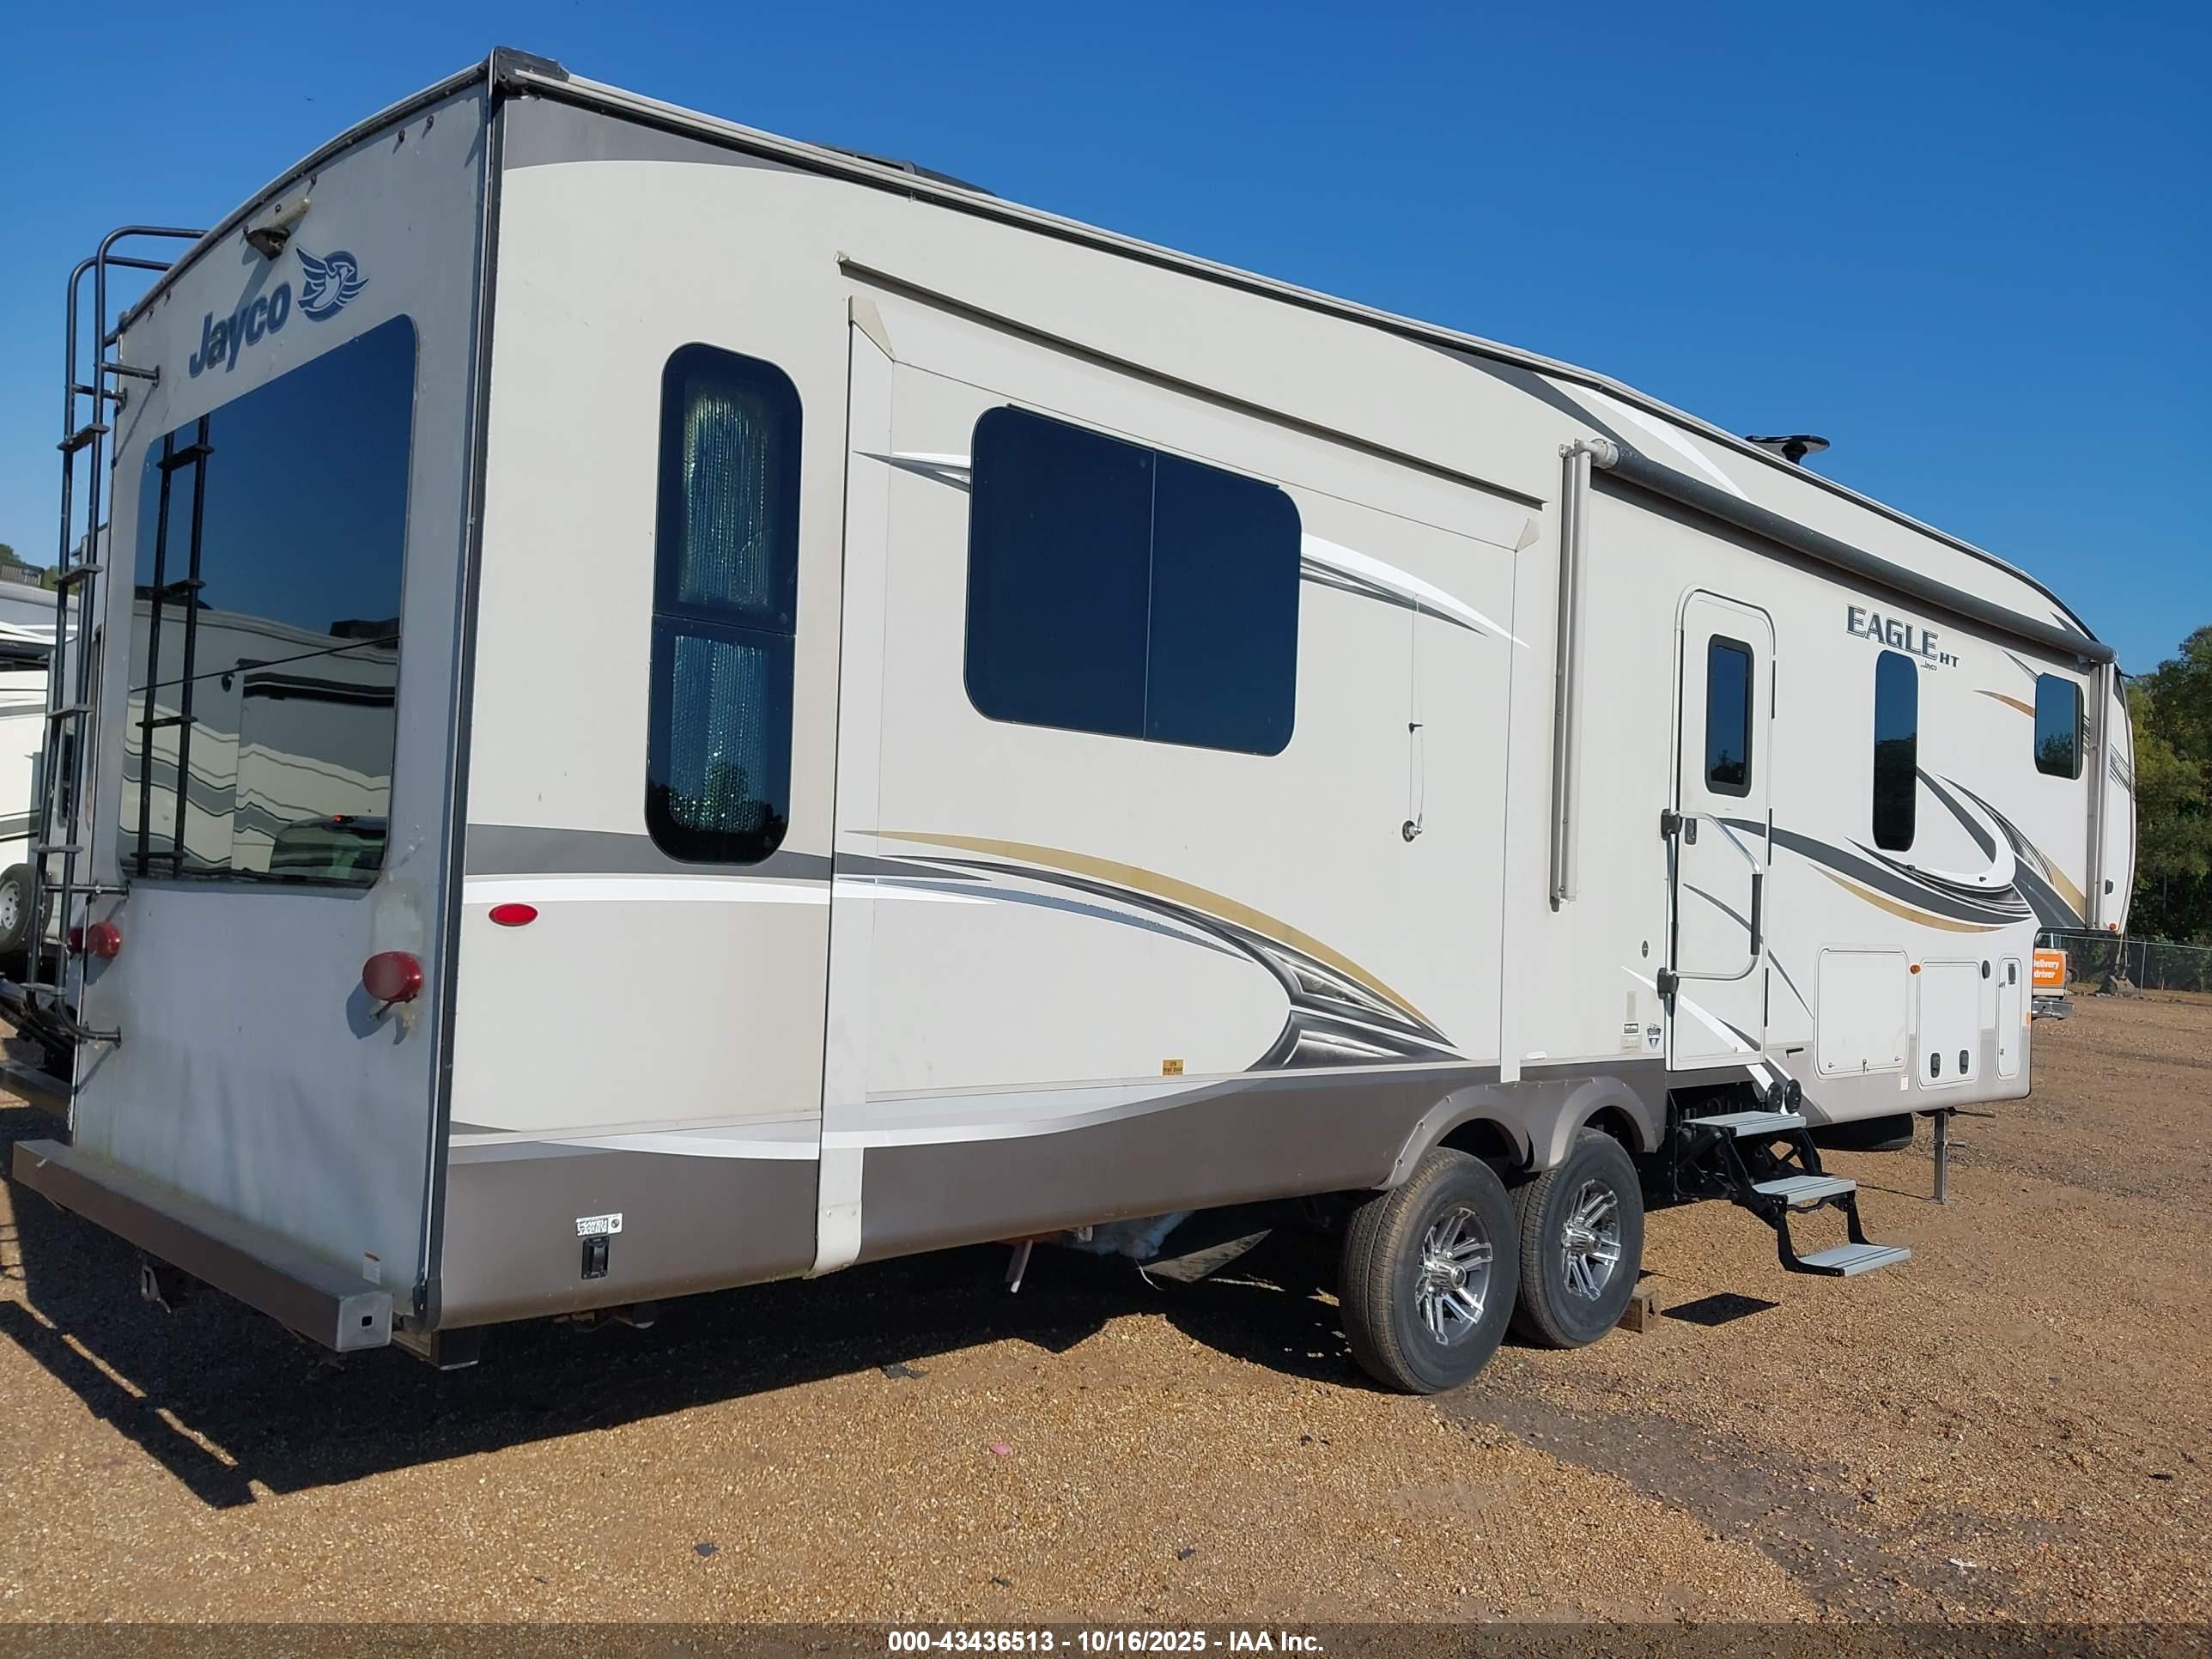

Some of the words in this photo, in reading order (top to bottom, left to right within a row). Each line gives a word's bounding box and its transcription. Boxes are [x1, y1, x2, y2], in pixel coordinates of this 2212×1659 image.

[188, 282, 292, 379] Jayco
[1846, 603, 1939, 661] EAGLE
[1939, 652, 1960, 668] HT
[2033, 969, 2056, 979] driver
